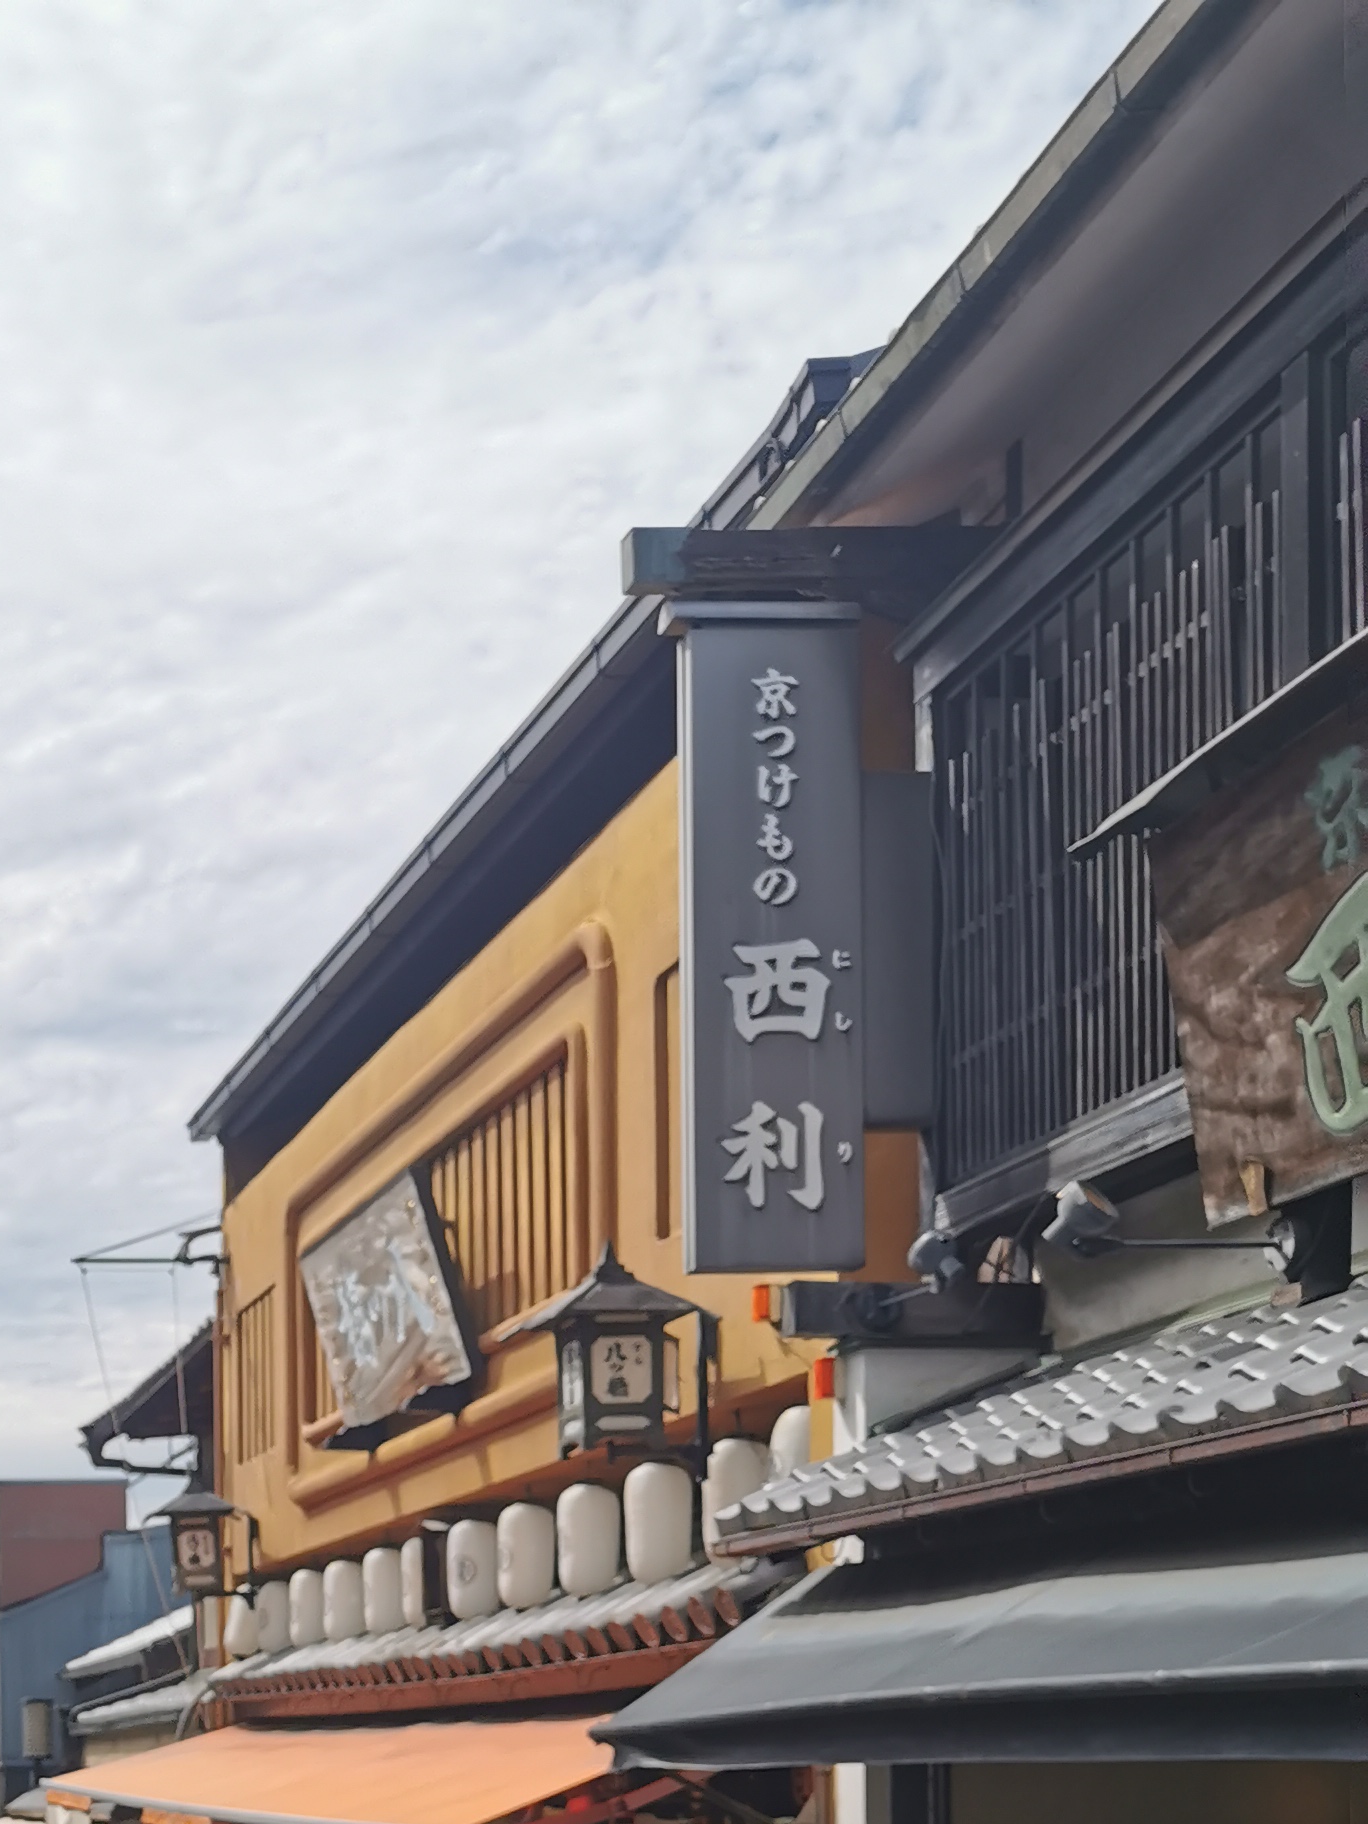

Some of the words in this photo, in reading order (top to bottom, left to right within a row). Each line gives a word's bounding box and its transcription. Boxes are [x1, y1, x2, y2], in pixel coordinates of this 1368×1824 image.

[751, 667, 800, 906] 京つけもの
[722, 938, 832, 1211] 西利
